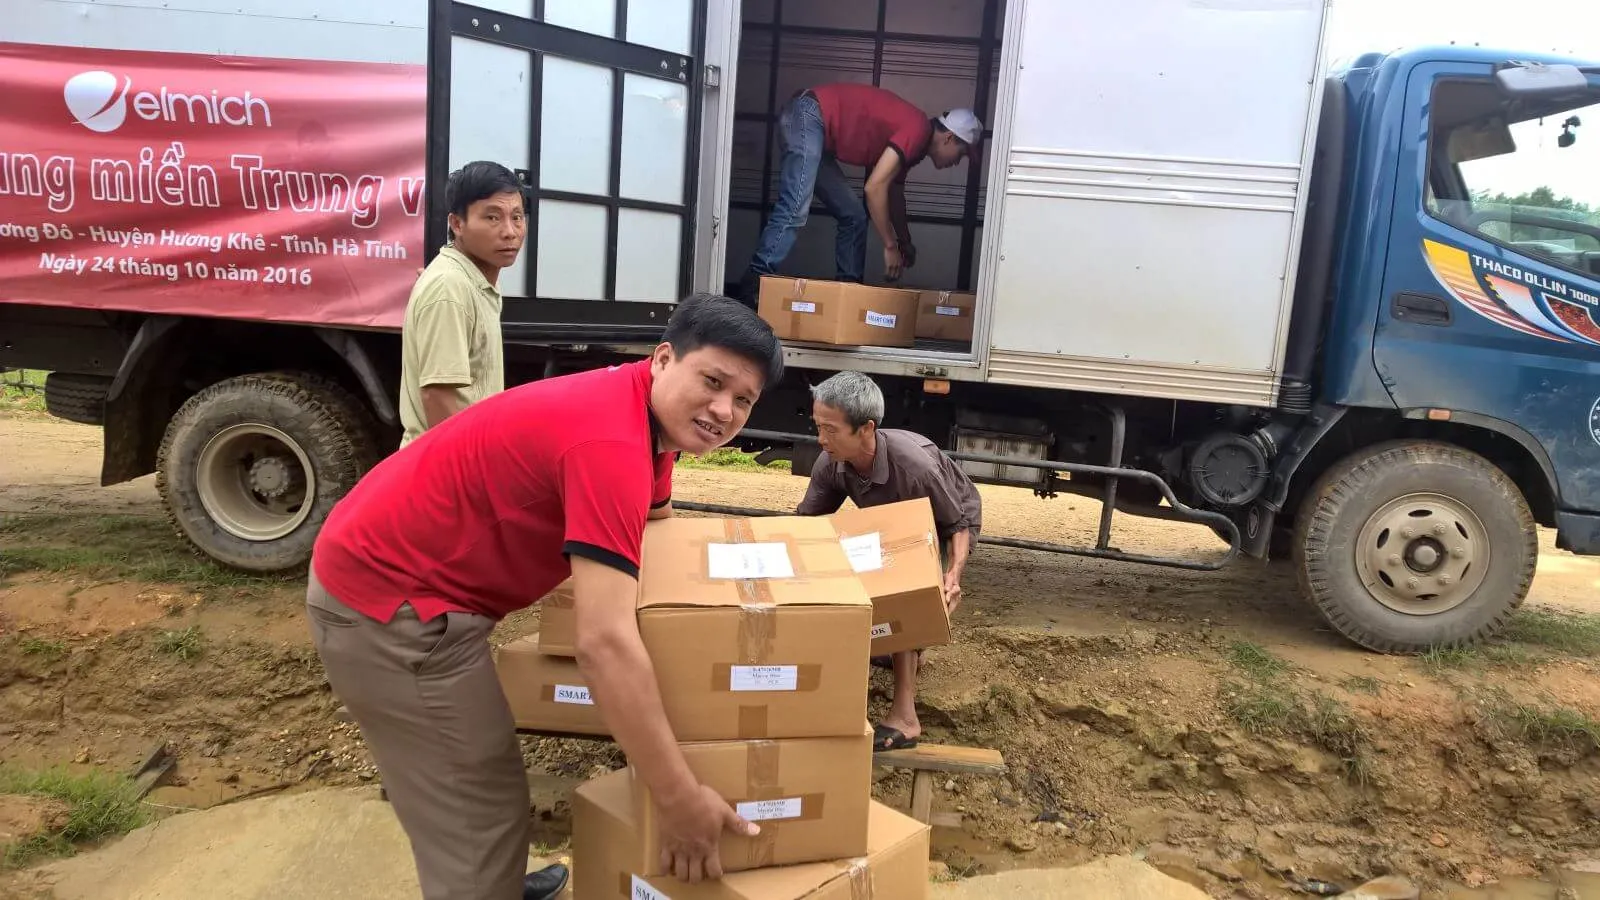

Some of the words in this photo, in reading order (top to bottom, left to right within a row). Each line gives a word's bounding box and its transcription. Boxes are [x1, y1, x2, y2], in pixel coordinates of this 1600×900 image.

[133, 86, 271, 127] elmich
[91, 142, 220, 207] miền
[231, 154, 384, 228] Trung
[42, 223, 73, 240] Đô
[89, 226, 154, 248] Huyện
[160, 230, 222, 252] Hương
[227, 233, 265, 251] Khê
[333, 238, 359, 256] Hà
[39, 253, 87, 274] Ngày
[91, 256, 115, 272] 24
[119, 258, 178, 281] tháng
[184, 262, 208, 279] 10
[214, 264, 258, 282] năm
[263, 266, 312, 285] 2016
[1472, 254, 1522, 280] THACO
[1525, 272, 1567, 296] OLLIN
